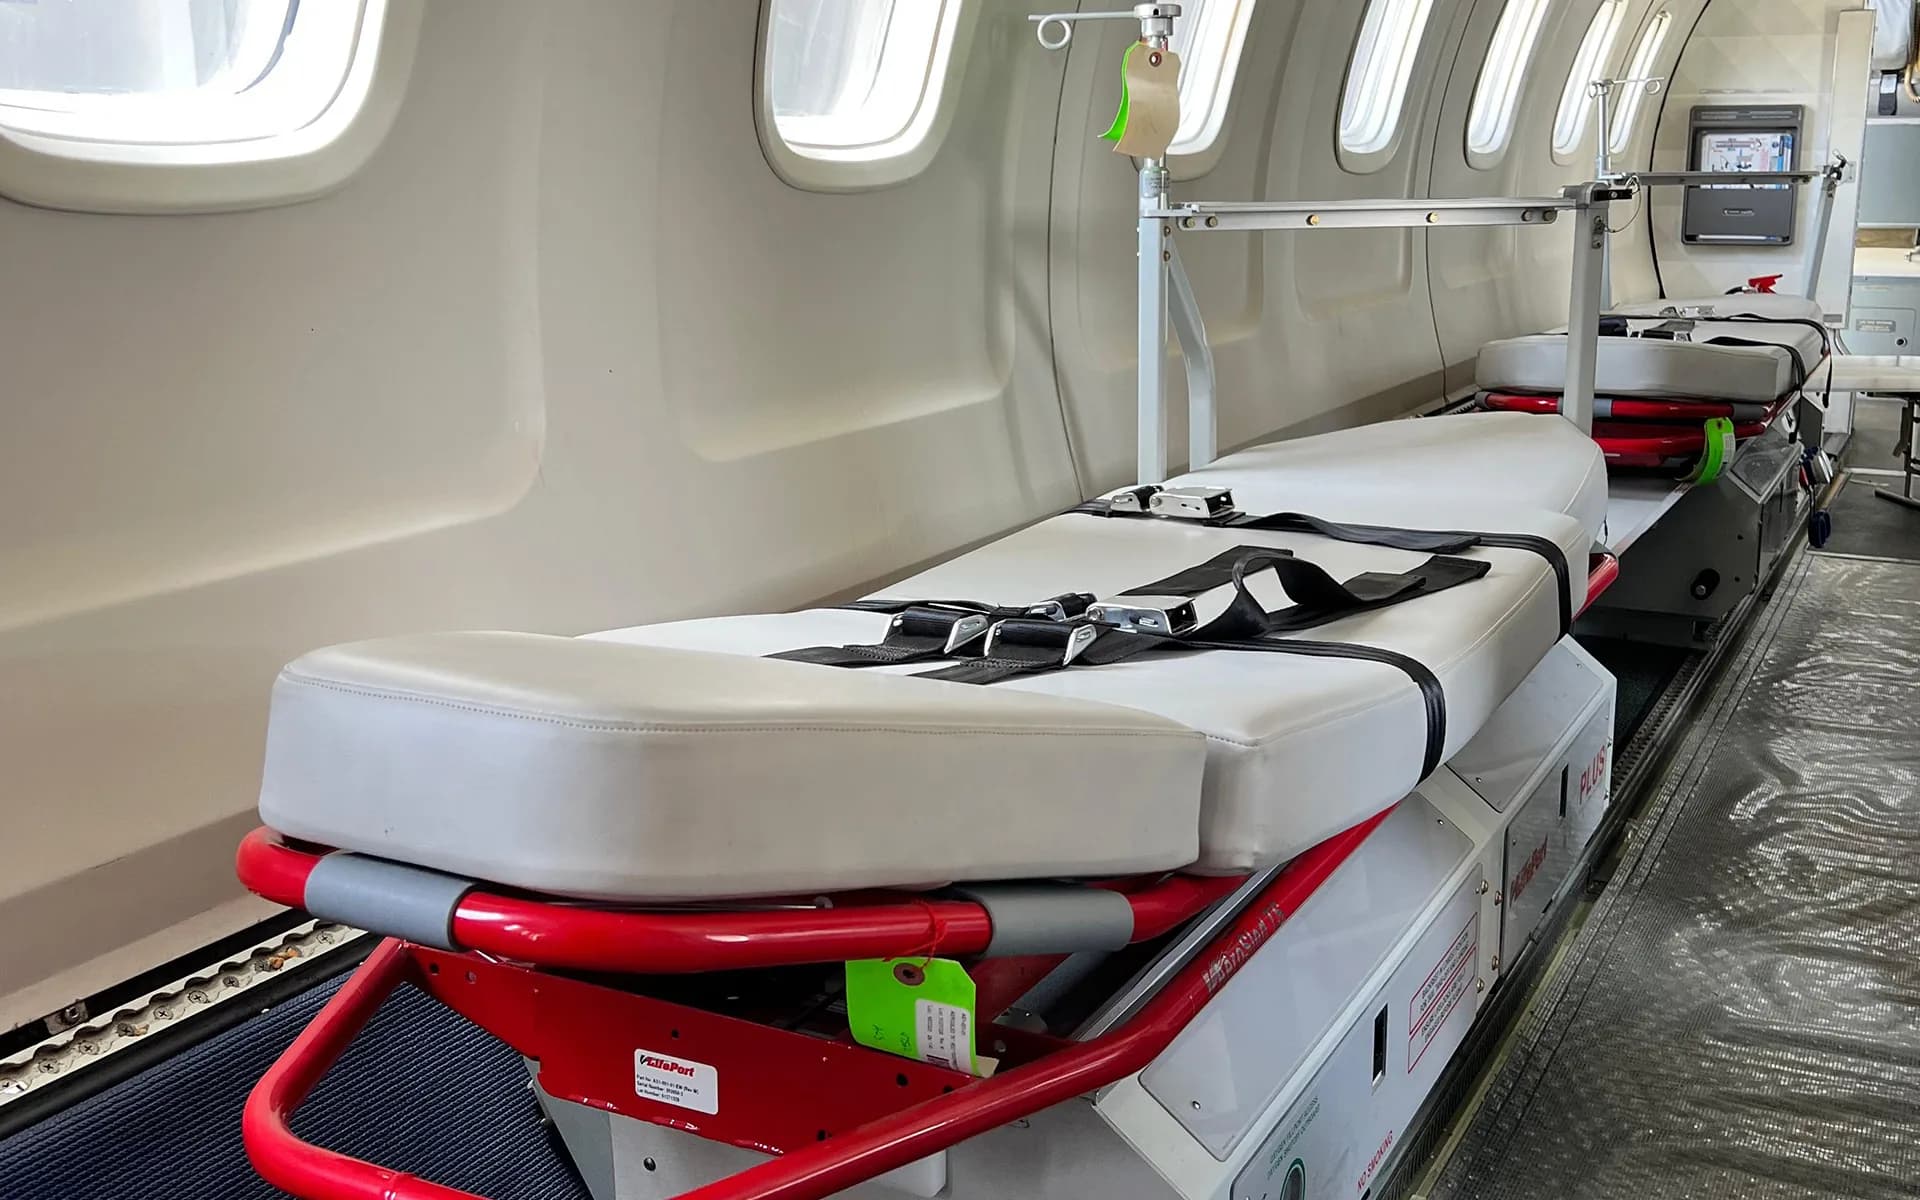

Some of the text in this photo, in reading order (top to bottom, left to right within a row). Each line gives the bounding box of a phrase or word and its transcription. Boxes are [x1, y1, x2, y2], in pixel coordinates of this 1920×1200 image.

[1579, 745, 1606, 805] PLUS
[640, 1055, 694, 1077] LifePort
[1357, 1129, 1394, 1193] NO SMOKING
